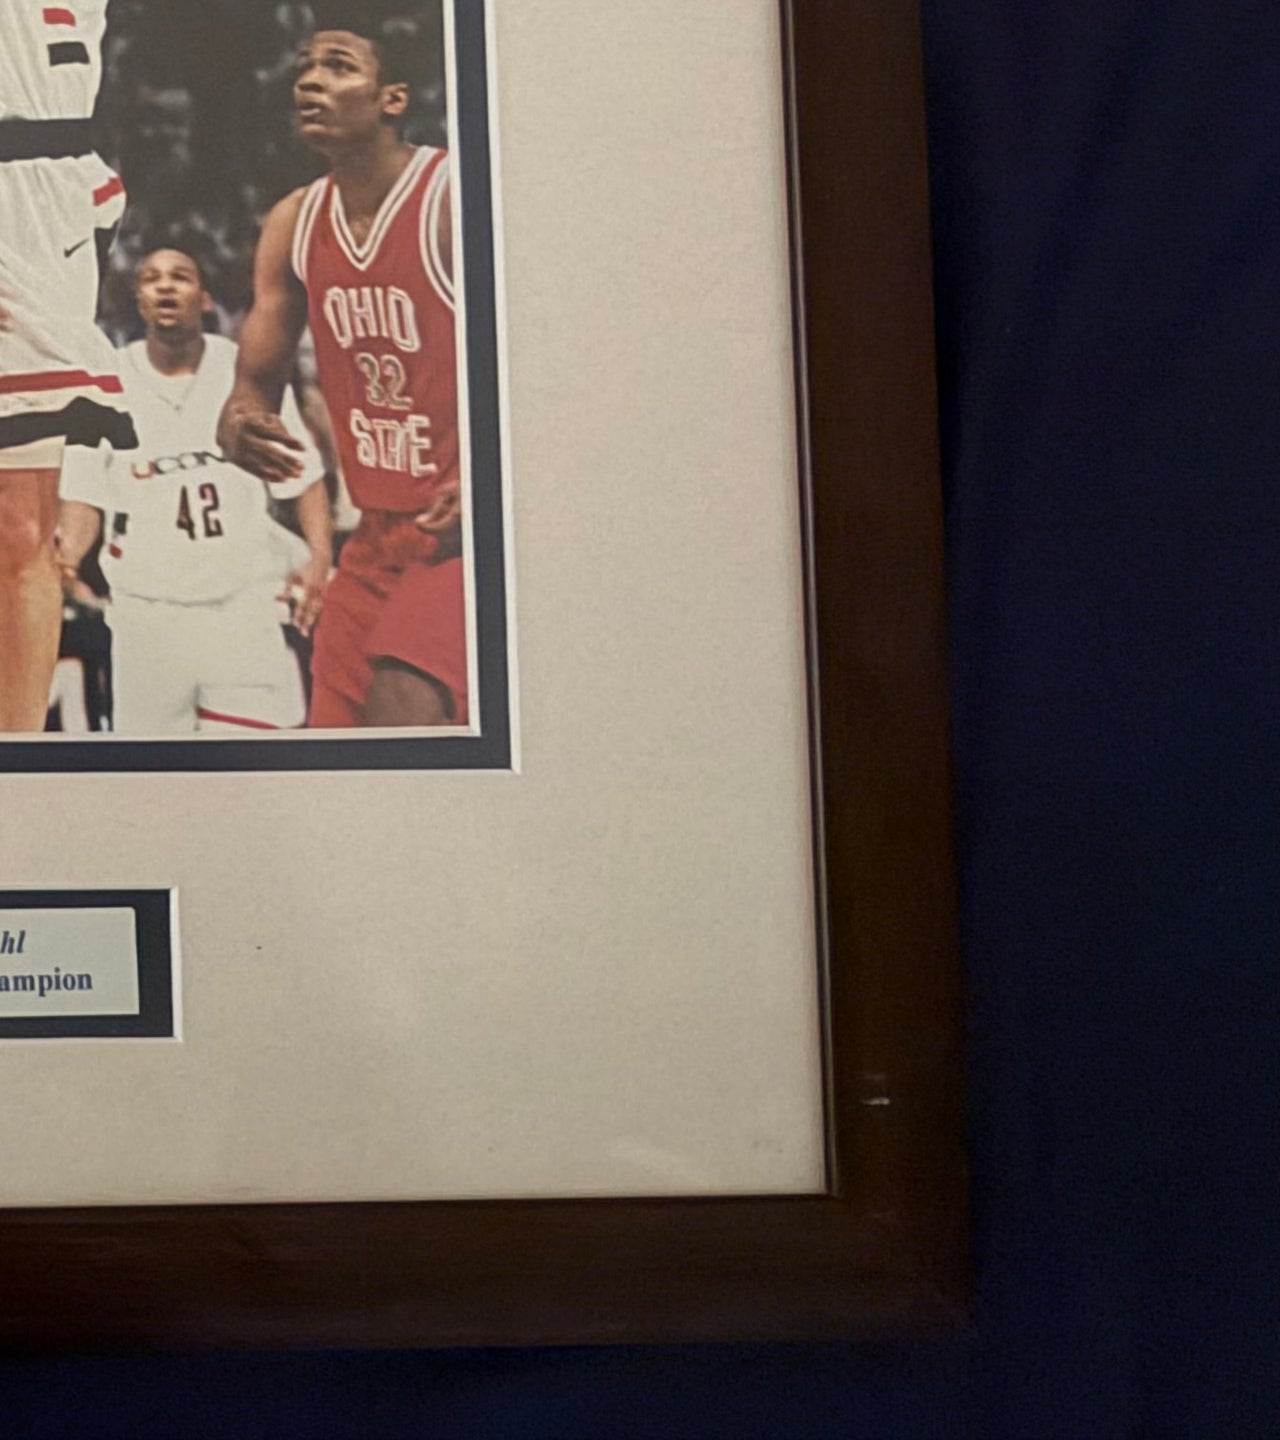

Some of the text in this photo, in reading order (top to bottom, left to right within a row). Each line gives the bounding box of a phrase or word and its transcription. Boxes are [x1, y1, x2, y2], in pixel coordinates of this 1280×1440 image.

[323, 285, 421, 353] OHIO
[355, 353, 414, 411] 32
[176, 482, 224, 541] 42
